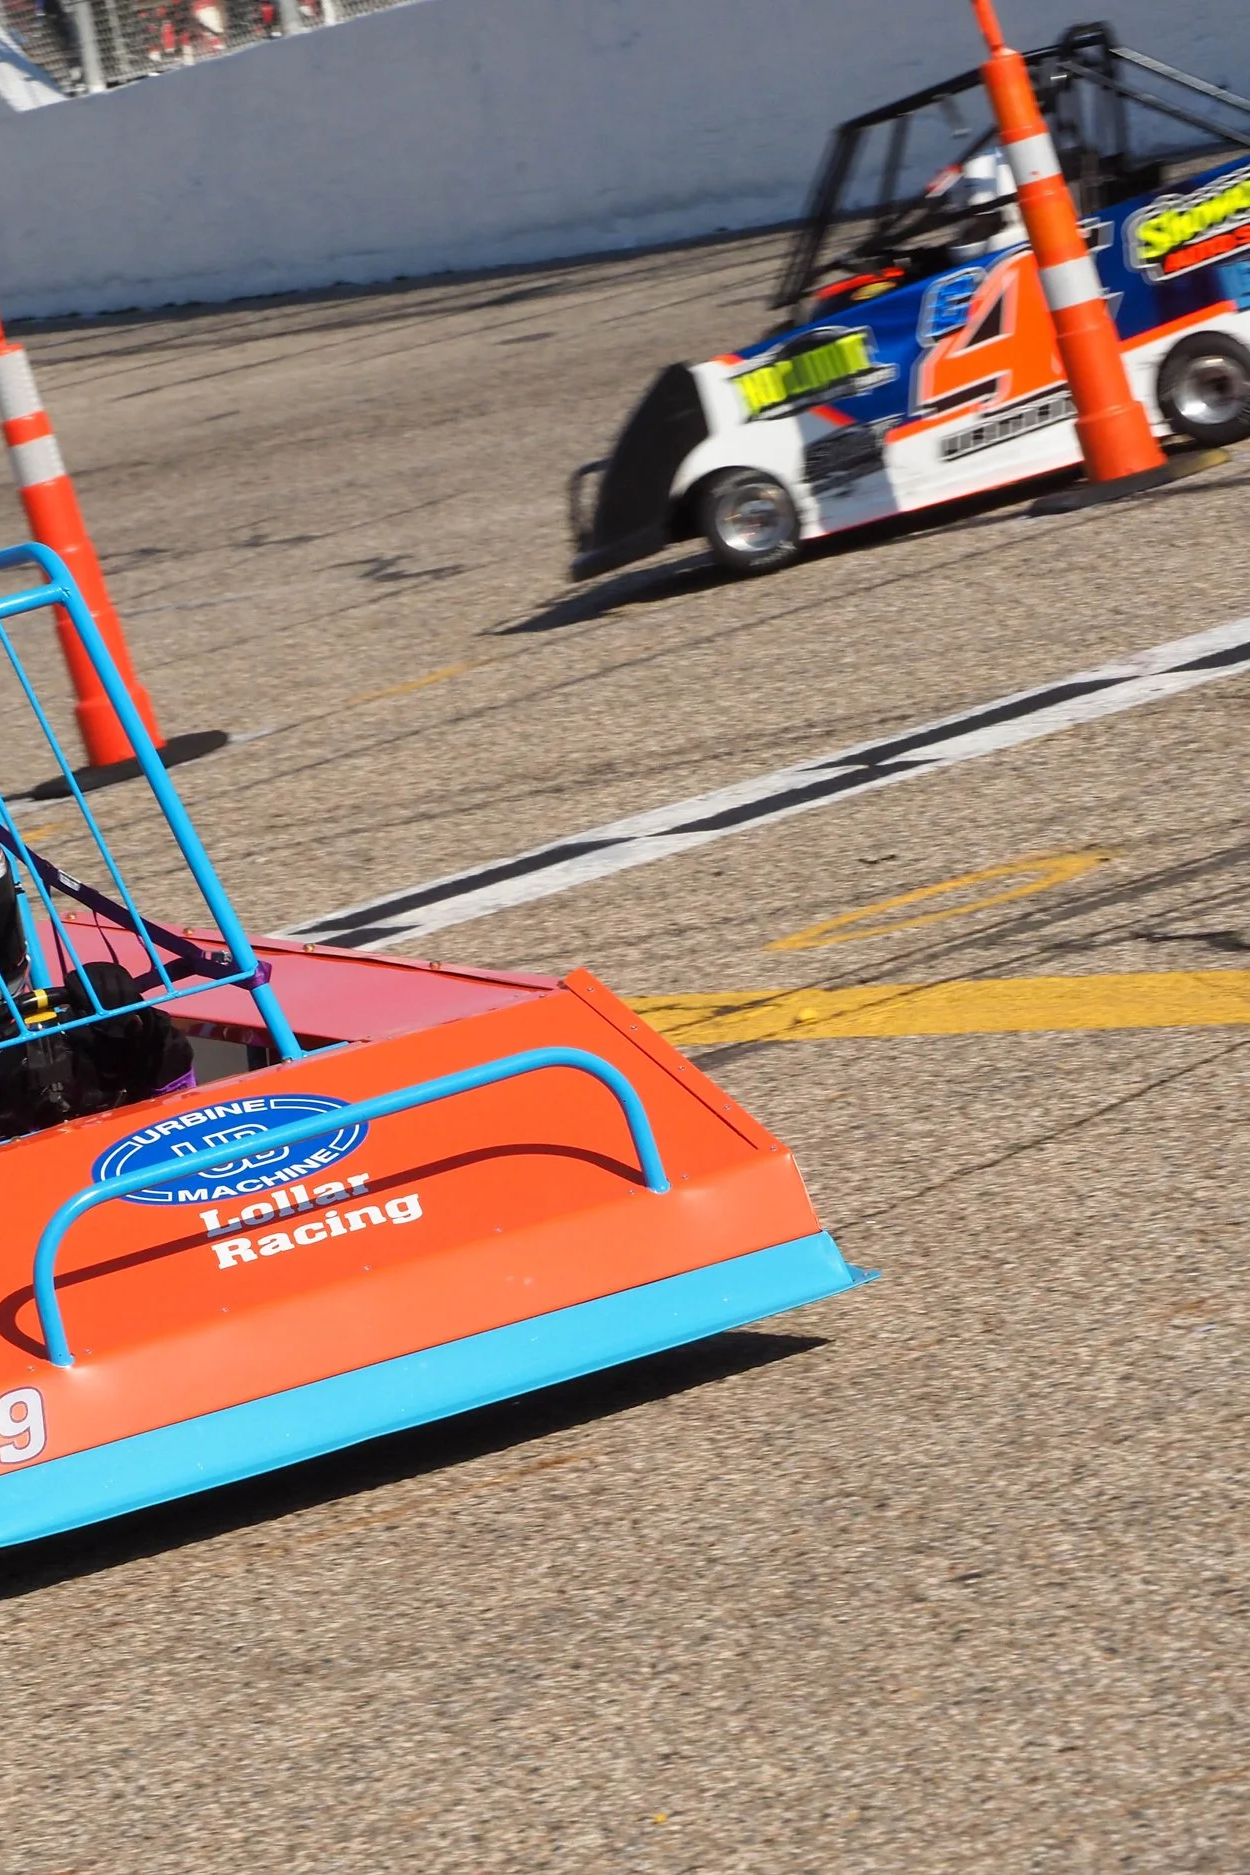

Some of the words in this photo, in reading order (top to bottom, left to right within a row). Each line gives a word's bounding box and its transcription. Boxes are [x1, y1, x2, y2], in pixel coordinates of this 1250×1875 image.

[132, 1098, 267, 1146] URBINE
[177, 1147, 340, 1202] MACHINE
[199, 1172, 370, 1238] Lollar
[210, 1193, 423, 1270] Racing
